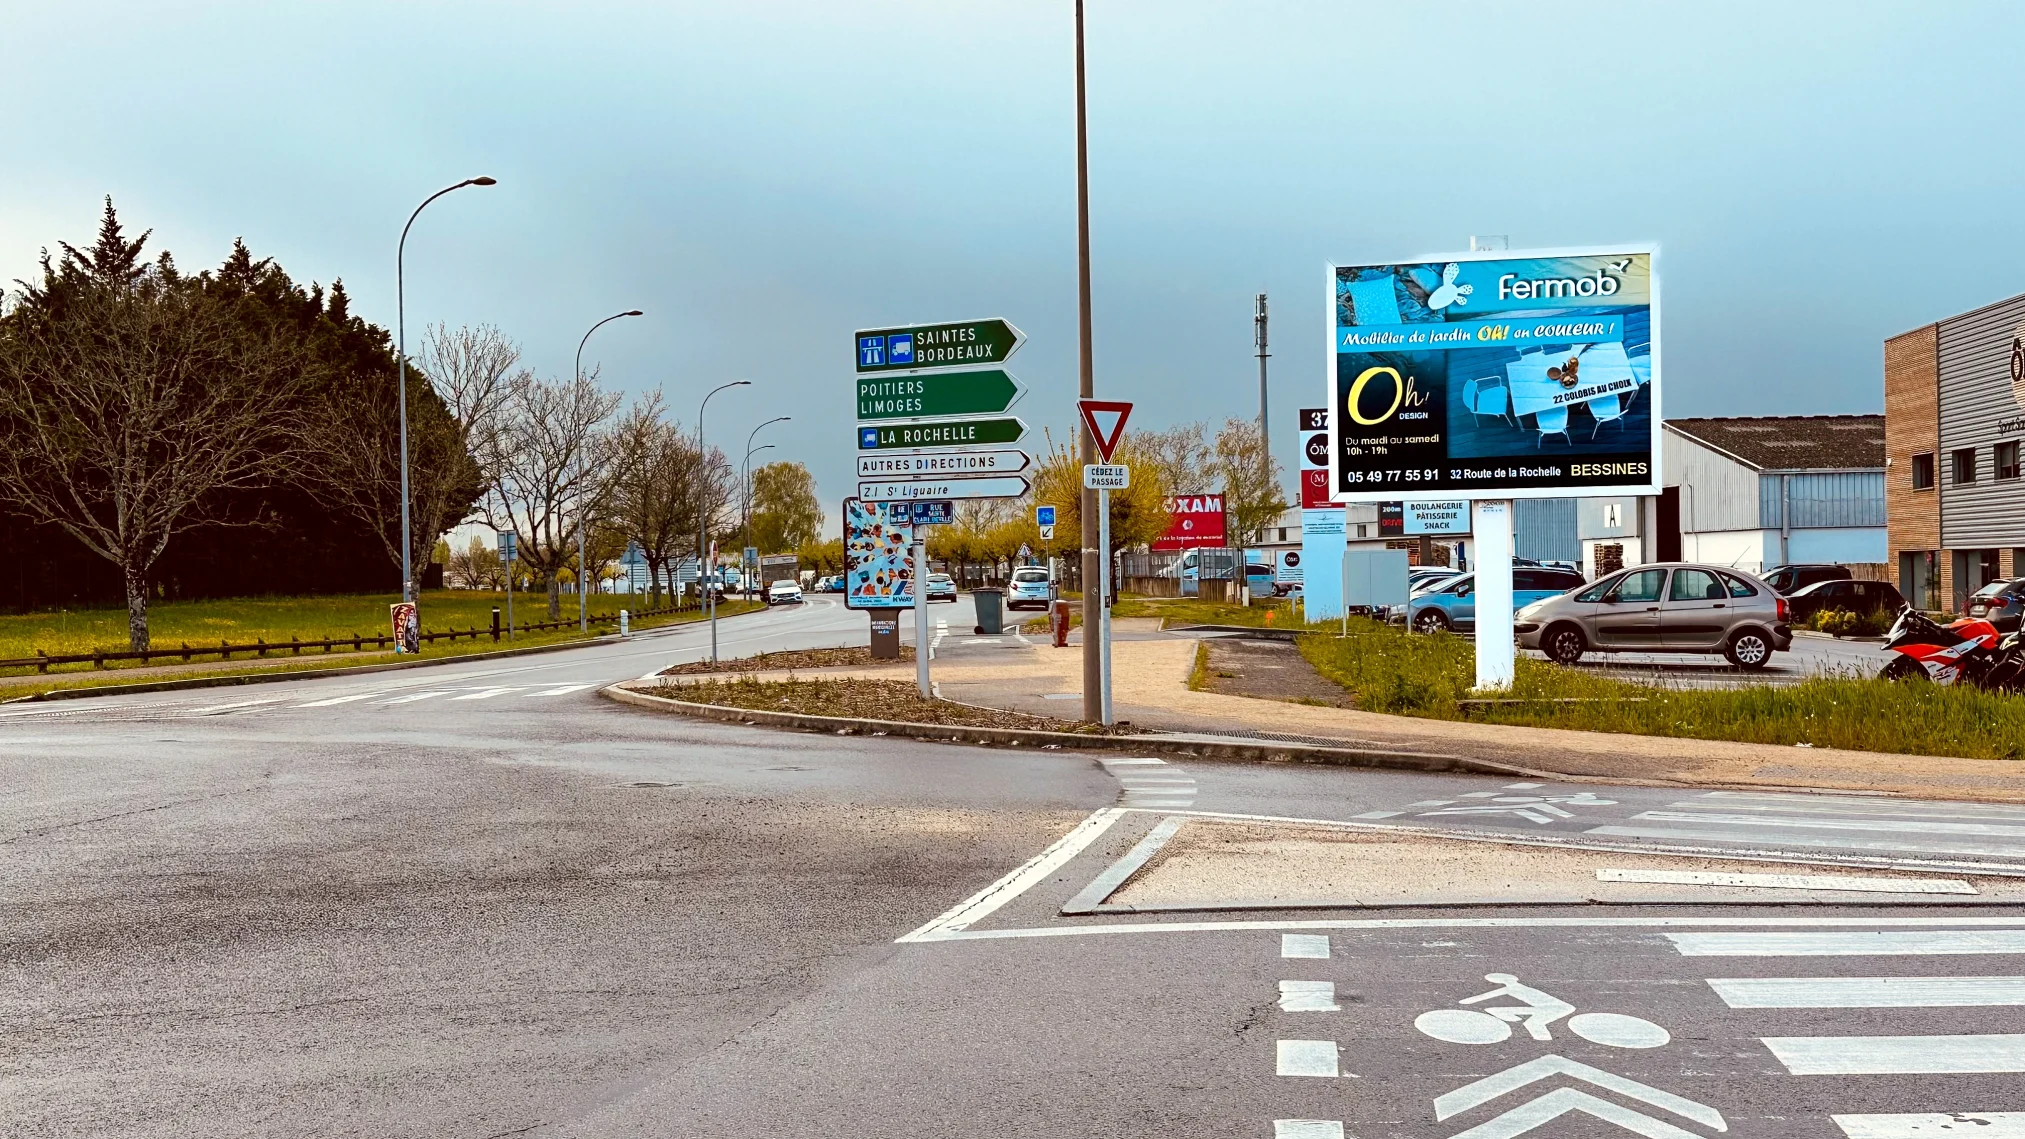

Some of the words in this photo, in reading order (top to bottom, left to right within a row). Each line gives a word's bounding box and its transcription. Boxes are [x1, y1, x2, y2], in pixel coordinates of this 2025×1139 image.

[1499, 270, 1617, 300] fermob
[917, 328, 976, 345] SAINTES
[1343, 331, 1405, 346] Mobilier
[1408, 330, 1426, 343] de
[1429, 328, 1471, 344] jardin
[1477, 324, 1510, 341] Oh!
[1513, 329, 1530, 338] en
[1533, 322, 1604, 337] COULEUR
[917, 344, 993, 362] BORDEAUX
[861, 381, 924, 397] POITIERS
[1348, 366, 1430, 426] Oh!
[1553, 394, 1564, 404] 22
[1597, 384, 1607, 394] AU
[1608, 378, 1632, 391] CHOIX
[861, 398, 922, 414] LIMOGES
[1399, 412, 1429, 420] DESIGN
[881, 429, 896, 444] LA
[904, 426, 976, 443] ROCHELLE
[1345, 437, 1359, 445] Du
[1360, 436, 1388, 445] mardi
[1404, 434, 1440, 444] samedi
[1346, 447, 1362, 455] 10h
[1371, 446, 1388, 455] 19h
[862, 460, 910, 472] AUTRES
[916, 457, 995, 470] DIRECTIONS
[1091, 467, 1112, 476] CÉDEZ
[1115, 468, 1123, 476] LE
[1450, 469, 1462, 479] 32
[1464, 468, 1492, 479] Route
[1494, 468, 1506, 478] de
[1508, 467, 1517, 477] la
[1519, 466, 1562, 477] Rochelle
[1570, 462, 1648, 476] BESSINES
[1091, 478, 1123, 486] PASSAGE
[1348, 471, 1364, 483] 05
[1366, 470, 1382, 482] 49
[1385, 470, 1401, 482] 77
[1404, 469, 1421, 481] 55
[1424, 469, 1439, 480] 91
[902, 485, 949, 498] Liguaire
[1410, 502, 1463, 511] BOULANGERIE
[1416, 511, 1458, 520] PÂTISSERIE
[1609, 504, 1617, 528] A
[1424, 522, 1450, 530] SNACK
